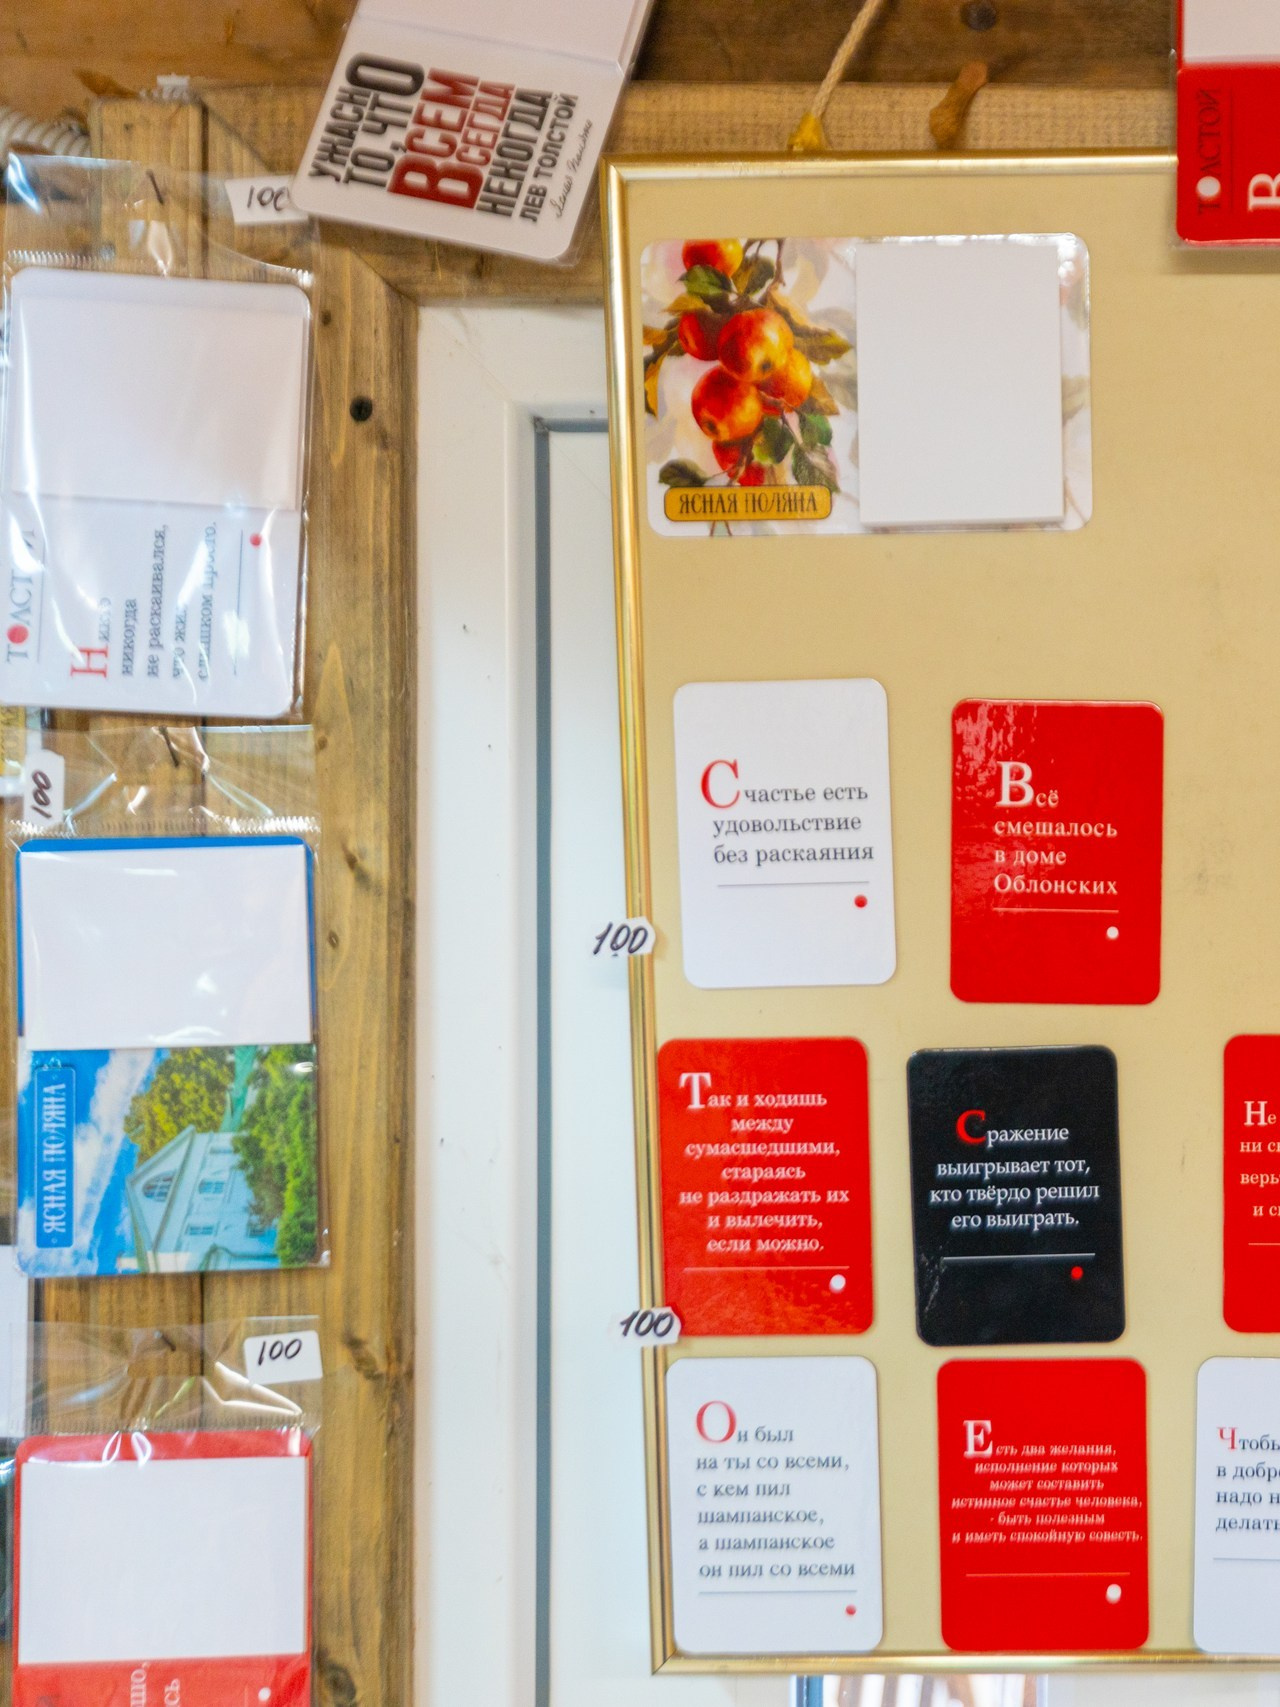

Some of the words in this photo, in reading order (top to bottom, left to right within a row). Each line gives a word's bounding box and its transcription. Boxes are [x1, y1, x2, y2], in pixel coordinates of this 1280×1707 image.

[308, 52, 424, 182] УЖАСНО
[388, 68, 484, 210] ВСЕМ
[533, 92, 579, 180] ТОЛСТОЙ
[475, 88, 554, 218] НЕКОГДА
[519, 183, 548, 223] ЛЕВ
[679, 493, 737, 514] ЯСНАЯ
[744, 491, 818, 513] ПОЛЯНА
[149, 524, 168, 650] раскаивался,
[122, 598, 137, 676] никогда
[148, 652, 159, 678] не
[31, 770, 52, 819] 100
[700, 760, 816, 809] Счастье
[822, 784, 868, 802] есть
[996, 761, 1059, 808] Всё
[712, 814, 862, 838] удовольствие
[993, 819, 1118, 838] смешалось
[713, 844, 748, 865] без
[755, 843, 874, 866] раскаяния
[994, 849, 1005, 864] в
[1014, 848, 1067, 867] доме
[993, 872, 1119, 895] Облонских
[593, 922, 648, 955] 100
[679, 1072, 731, 1109] Так
[736, 1095, 749, 1107] и
[754, 1094, 827, 1108] ходишь
[43, 1083, 66, 1163] ПОЛЯНА
[1243, 1101, 1276, 1126] Не
[730, 1118, 794, 1133] между
[956, 1109, 1069, 1148] Сражение
[685, 1142, 841, 1159] сумасшедшими,
[1240, 1142, 1262, 1153] ни
[721, 1166, 806, 1182] стараясь
[937, 1161, 1050, 1180] выигрывает
[1055, 1159, 1091, 1173] тот,
[43, 1169, 66, 1233] ЯСНАЯ
[679, 1191, 702, 1205] не
[707, 1190, 821, 1207] раздражать
[826, 1190, 850, 1202] их
[929, 1189, 962, 1202] кто
[966, 1186, 1031, 1205] твёрдо
[1036, 1185, 1100, 1205] решил
[707, 1215, 721, 1228] и
[725, 1214, 823, 1229] вылечить,
[951, 1215, 981, 1228] его
[987, 1212, 1079, 1231] выиграть.
[1253, 1206, 1263, 1217] и
[706, 1239, 751, 1253] если
[756, 1239, 824, 1252] можно.
[620, 1308, 674, 1337] 100
[258, 1338, 302, 1366] 100
[696, 1401, 748, 1444] Он
[755, 1426, 794, 1442] был
[963, 1420, 1017, 1458] Есть
[1021, 1445, 1045, 1456] два
[1050, 1444, 1116, 1455] желания,
[696, 1458, 717, 1470] на
[724, 1457, 750, 1469] ты
[756, 1457, 778, 1469] со
[785, 1456, 849, 1470] всеми,
[975, 1463, 1057, 1474] исполнение
[1062, 1461, 1118, 1475] которых
[1217, 1465, 1226, 1477] в
[713, 1484, 749, 1496] кем
[756, 1483, 790, 1496] пил
[990, 1480, 1033, 1491] может
[1037, 1479, 1104, 1490] составить
[952, 1497, 1016, 1509] истинное
[1019, 1497, 1071, 1508] счастье
[1076, 1496, 1142, 1508] человека,
[1216, 1491, 1262, 1506] надо
[698, 1510, 824, 1525] шампанское,
[998, 1511, 1032, 1525] быть
[1036, 1514, 1105, 1525] полезным
[715, 1536, 835, 1550] шампанское
[965, 1532, 1006, 1544] иметь
[1010, 1529, 1085, 1544] спокойную
[1089, 1531, 1143, 1542] совесть.
[699, 1565, 721, 1577] он
[729, 1565, 763, 1577] пил
[770, 1564, 791, 1576] со
[798, 1563, 855, 1576] всеми
